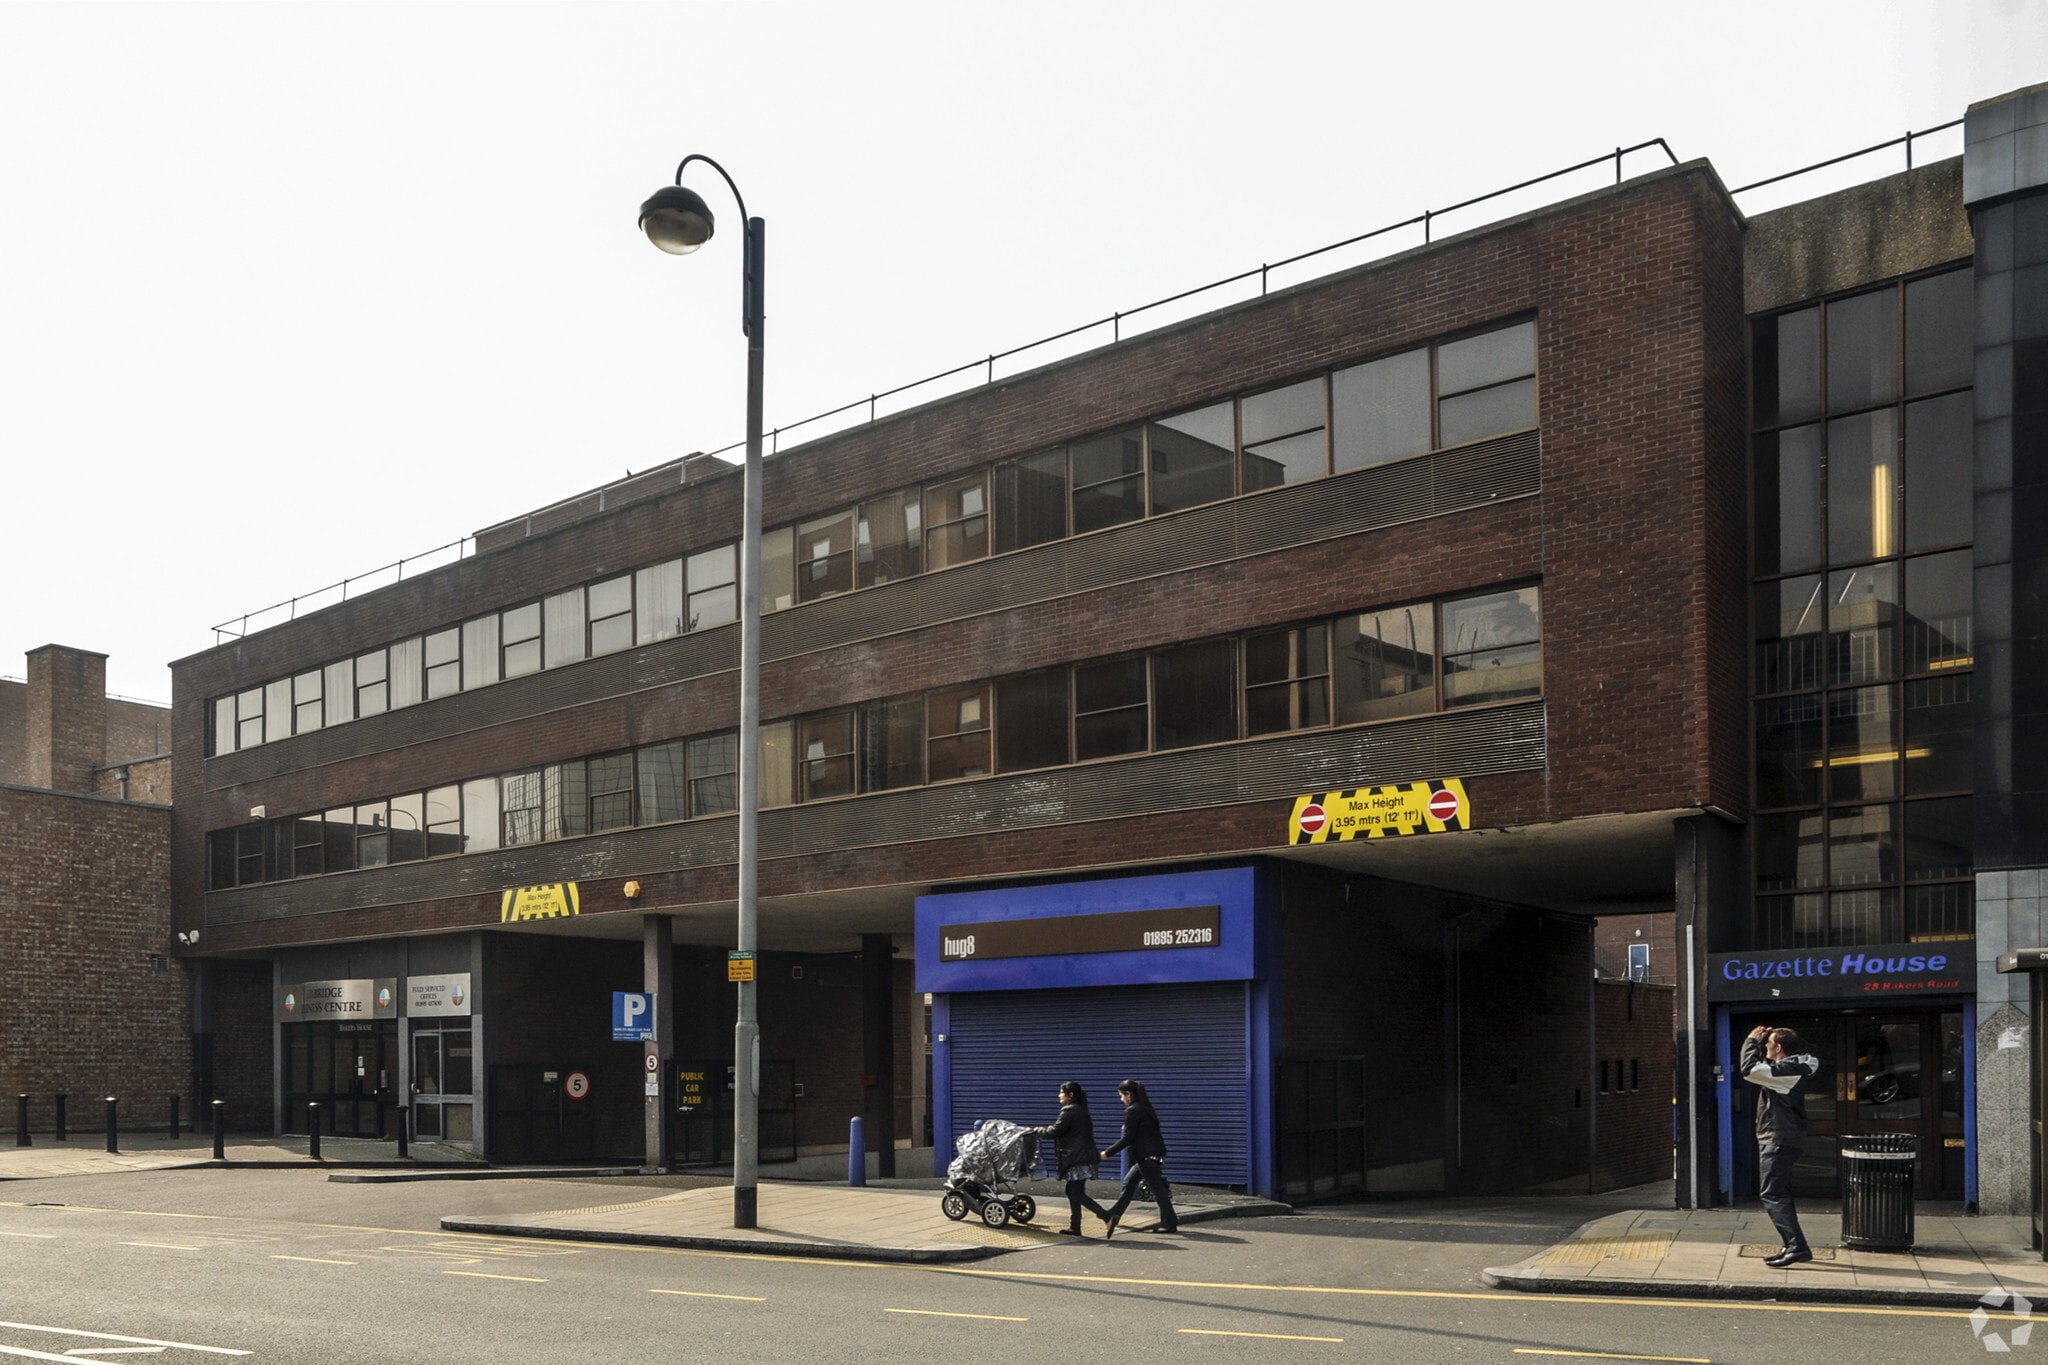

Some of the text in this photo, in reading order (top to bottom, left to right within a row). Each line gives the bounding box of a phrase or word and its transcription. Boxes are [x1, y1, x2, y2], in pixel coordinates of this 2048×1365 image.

[1349, 797, 1404, 811] Max Height
[1335, 817, 1356, 828] 3.95
[1359, 814, 1381, 825] mtrs
[945, 927, 1212, 957] hug8 01895 252316
[1723, 953, 1948, 980] Gazette House
[1882, 981, 1924, 991] Bakers
[1927, 979, 1959, 988] Road
[324, 1001, 362, 1013] CENTRE
[624, 994, 646, 1027] P
[649, 1058, 655, 1068] 5
[680, 1072, 704, 1080] PUBLIC
[573, 1079, 582, 1091] 5
[685, 1084, 700, 1092] CAR
[683, 1096, 702, 1104] PARK
